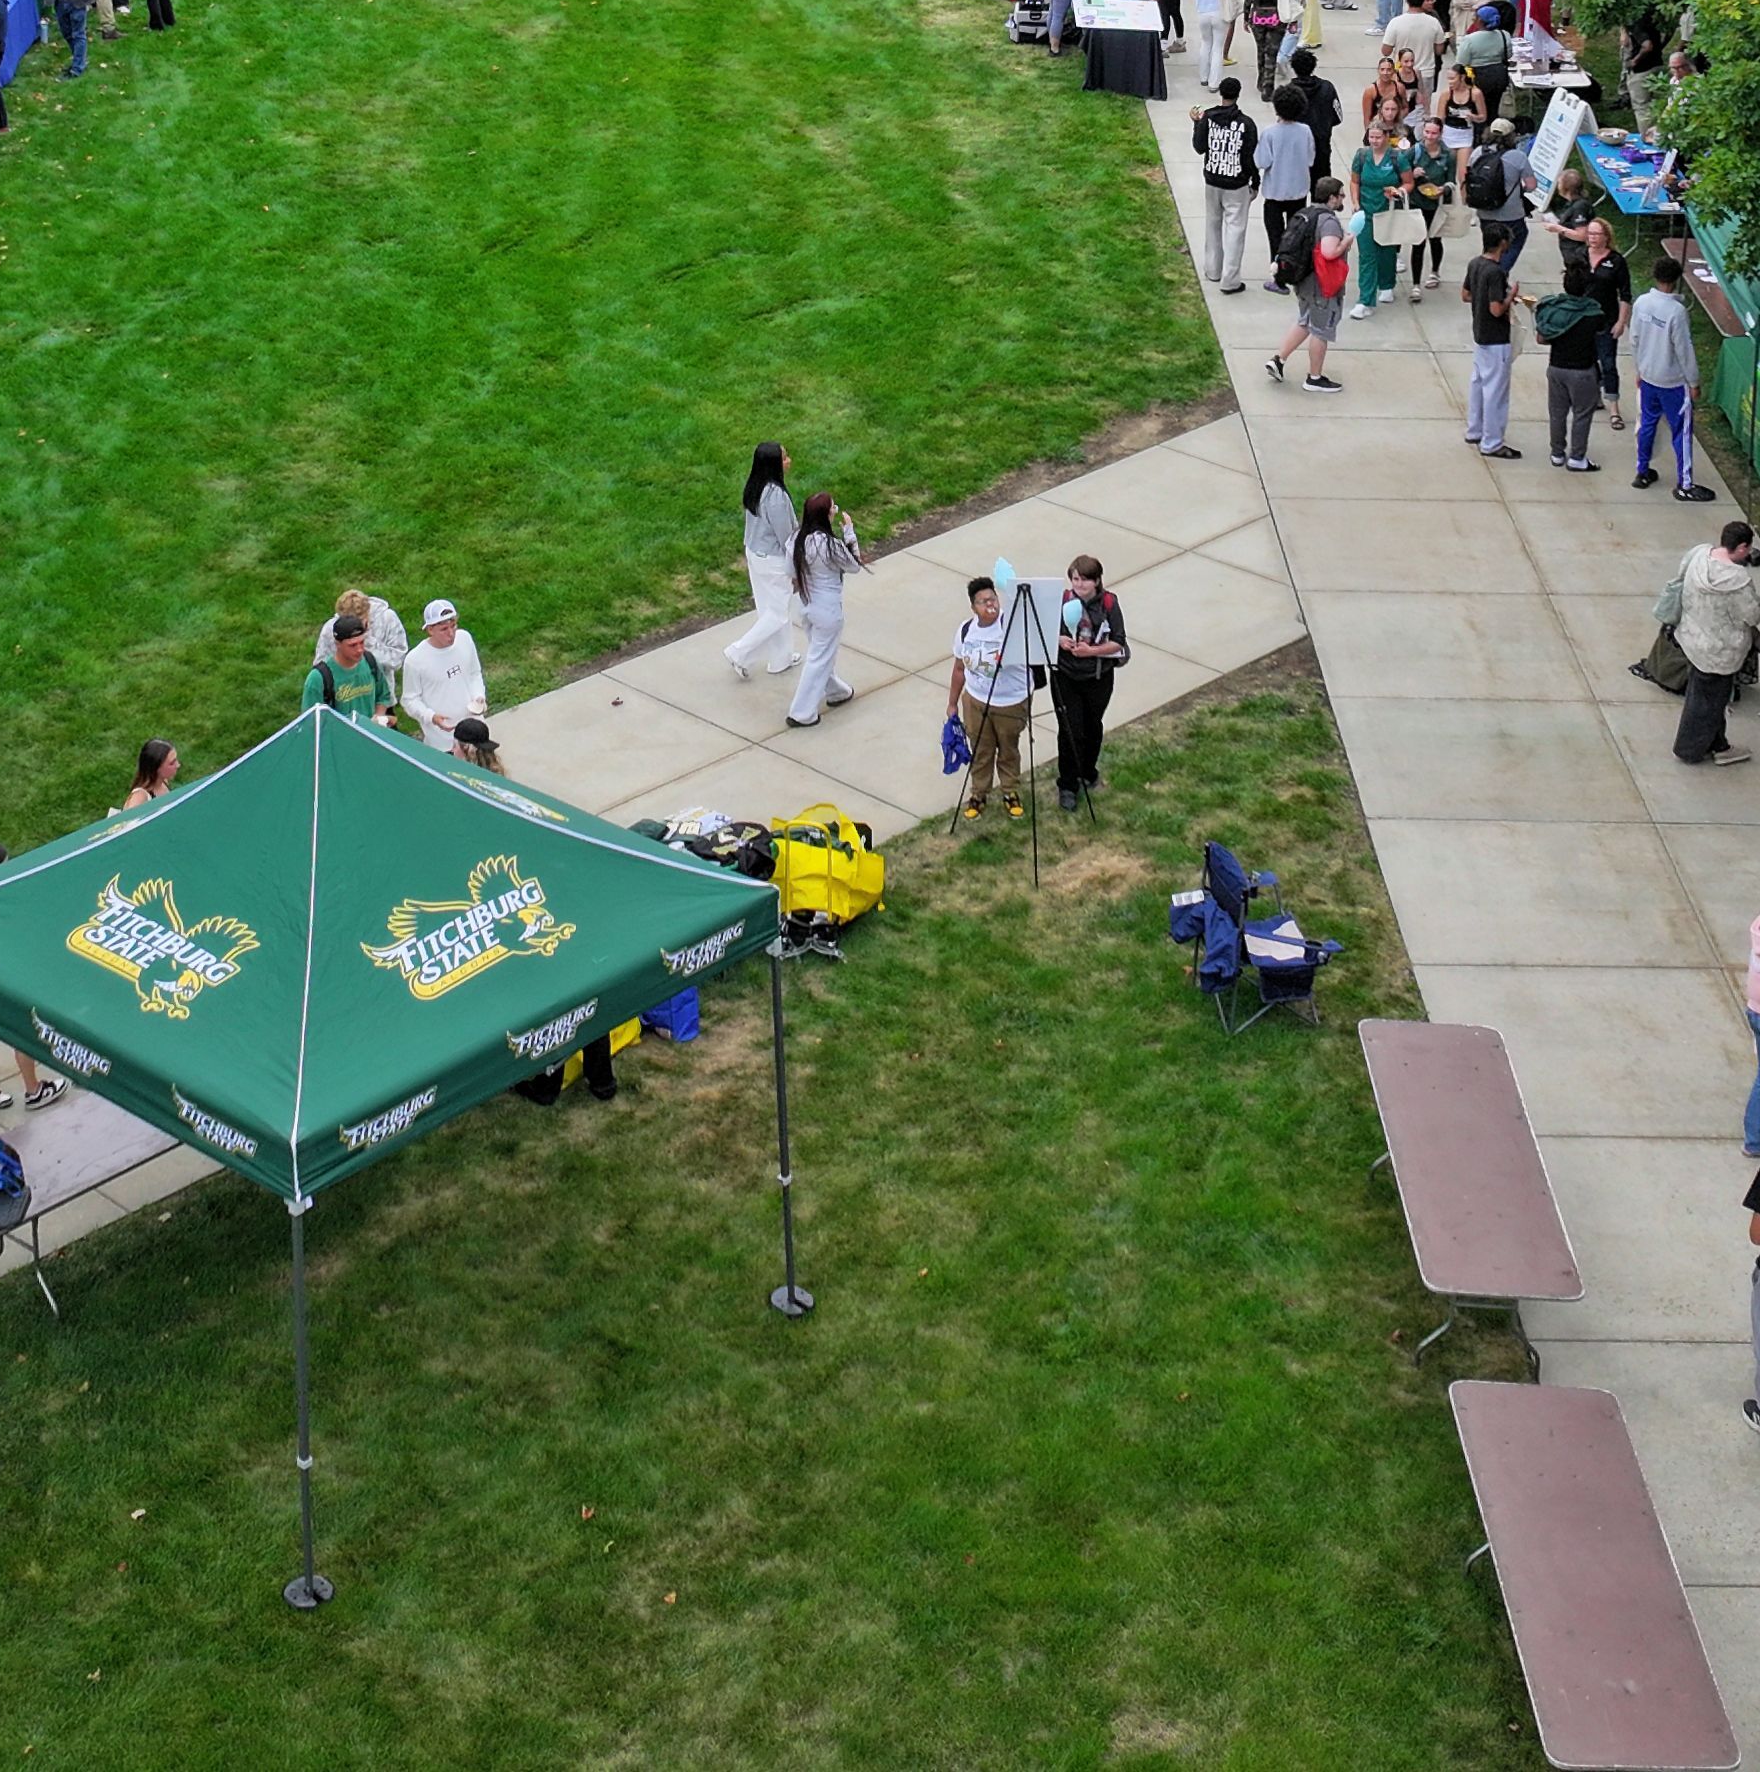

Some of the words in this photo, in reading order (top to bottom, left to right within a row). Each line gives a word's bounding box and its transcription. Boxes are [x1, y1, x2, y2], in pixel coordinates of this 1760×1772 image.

[1253, 11, 1279, 26] body
[1208, 127, 1242, 143] AWFUL
[1209, 149, 1241, 166] OUGH
[85, 925, 166, 970] STATE
[96, 892, 235, 981] FITCHBURG
[394, 881, 542, 972] FITCHBURG
[668, 921, 744, 971] FITCHBURG
[418, 922, 500, 985] STATE
[429, 947, 501, 992] FALCONS
[684, 946, 724, 974] STATE
[39, 1023, 110, 1074] FITCHBURG
[513, 999, 597, 1054] FITCHBURG
[532, 1026, 574, 1057] STATE
[53, 1047, 89, 1073] STATE
[180, 1103, 256, 1155] FITCHBURG
[345, 1087, 435, 1147] FITCHBURG
